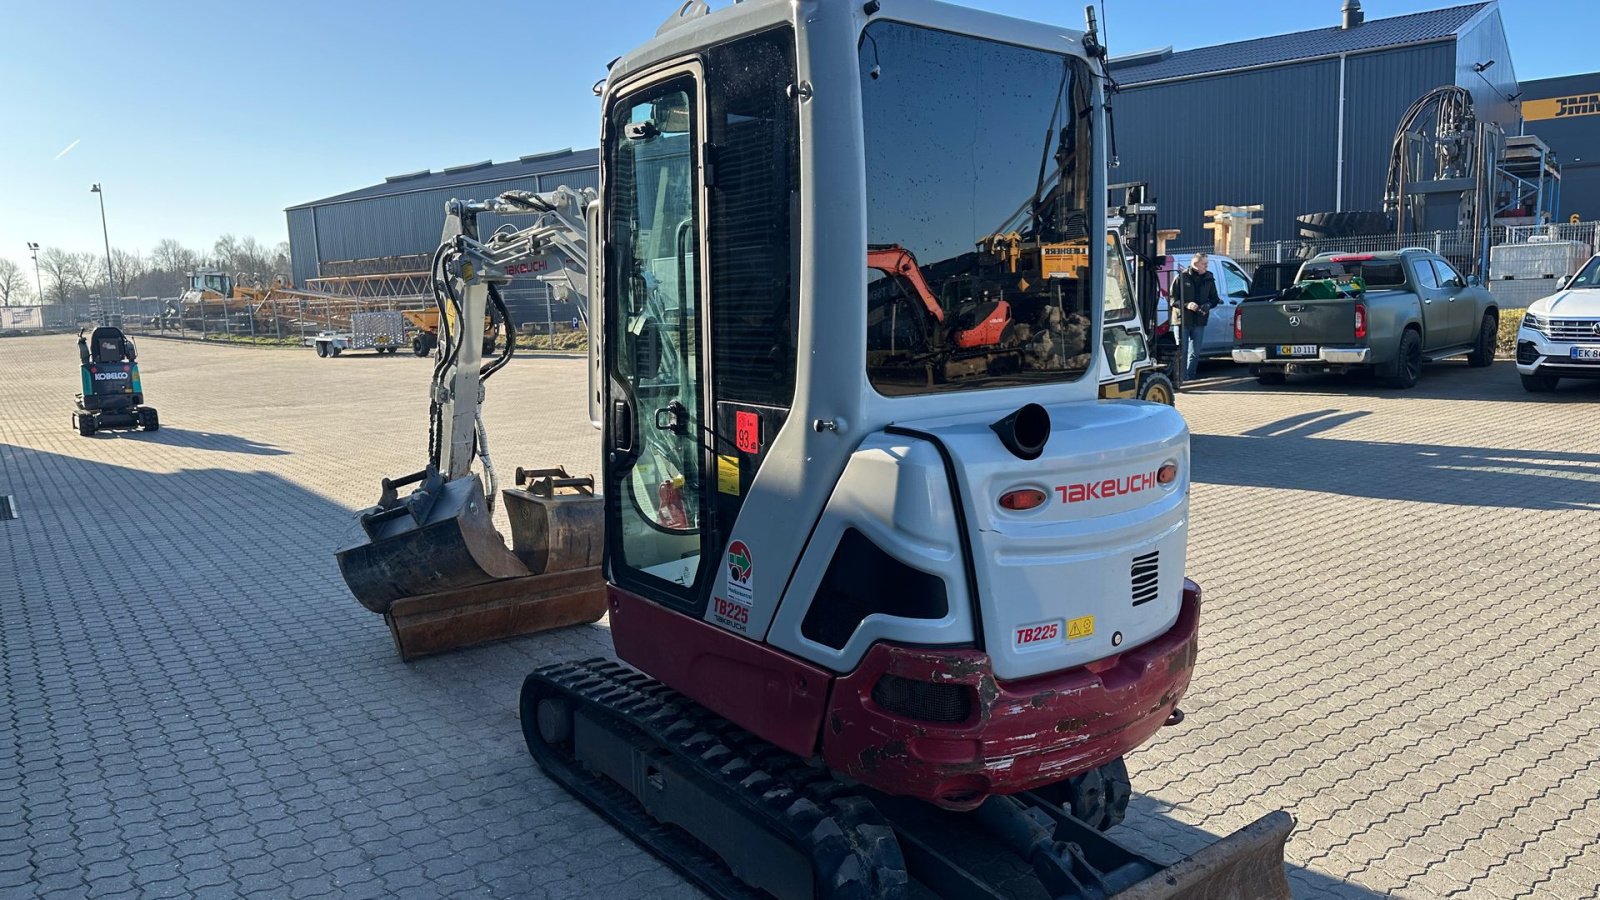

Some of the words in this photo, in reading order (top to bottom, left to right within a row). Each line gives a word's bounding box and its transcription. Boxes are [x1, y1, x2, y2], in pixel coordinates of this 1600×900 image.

[1570, 213, 1580, 225] 6
[504, 260, 548, 275] TAKEUCHI
[1281, 346, 1291, 354] CH
[1293, 346, 1302, 354] 10
[1578, 349, 1590, 358] EK
[1592, 349, 1600, 358] 8
[94, 372, 128, 381] KOBELCO
[738, 428, 749, 449] 93
[1055, 471, 1156, 504] TAKEUCHI
[713, 596, 749, 624] TB225
[713, 614, 747, 633] TAKEUCHI
[1016, 623, 1058, 644] TB225
